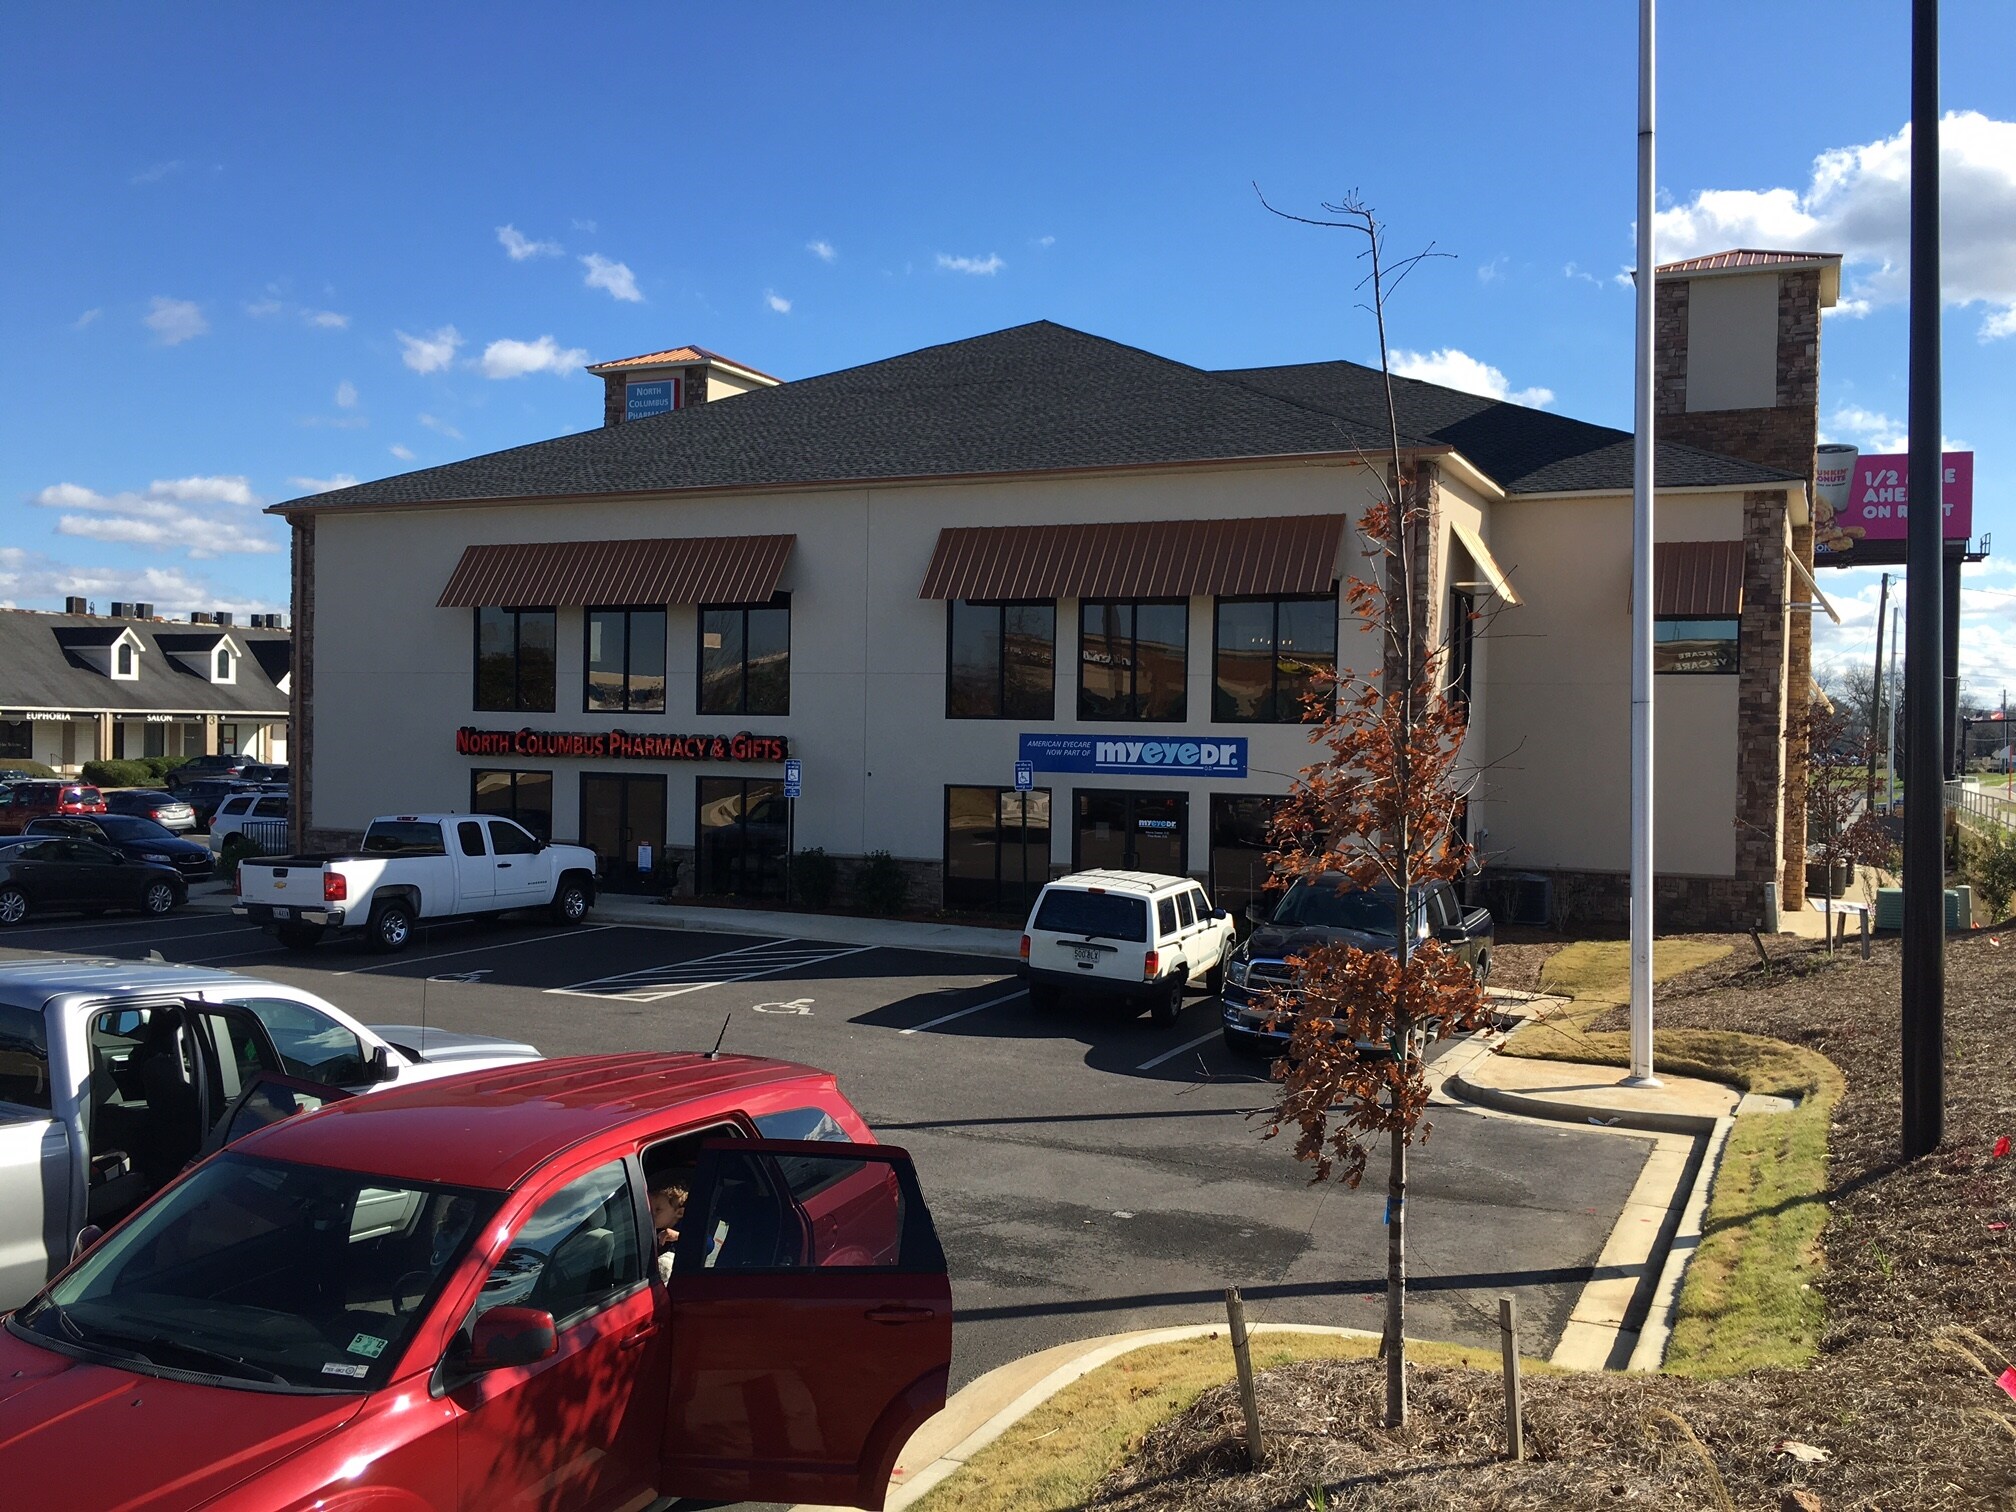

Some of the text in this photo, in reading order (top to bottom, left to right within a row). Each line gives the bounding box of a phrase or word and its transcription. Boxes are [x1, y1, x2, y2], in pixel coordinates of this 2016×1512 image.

[1864, 469, 1899, 487] 1/2
[1862, 487, 1908, 503] AHE
[1862, 505, 1891, 519] ON
[26, 711, 71, 721] EUPHORIA
[146, 714, 173, 722] SALON
[208, 714, 216, 726] 3
[456, 730, 782, 759] NORTH COLUMBUS PHARMACY & GIFTS
[1026, 740, 1092, 749] AMERICAN EYECARE
[1063, 749, 1080, 757] PART
